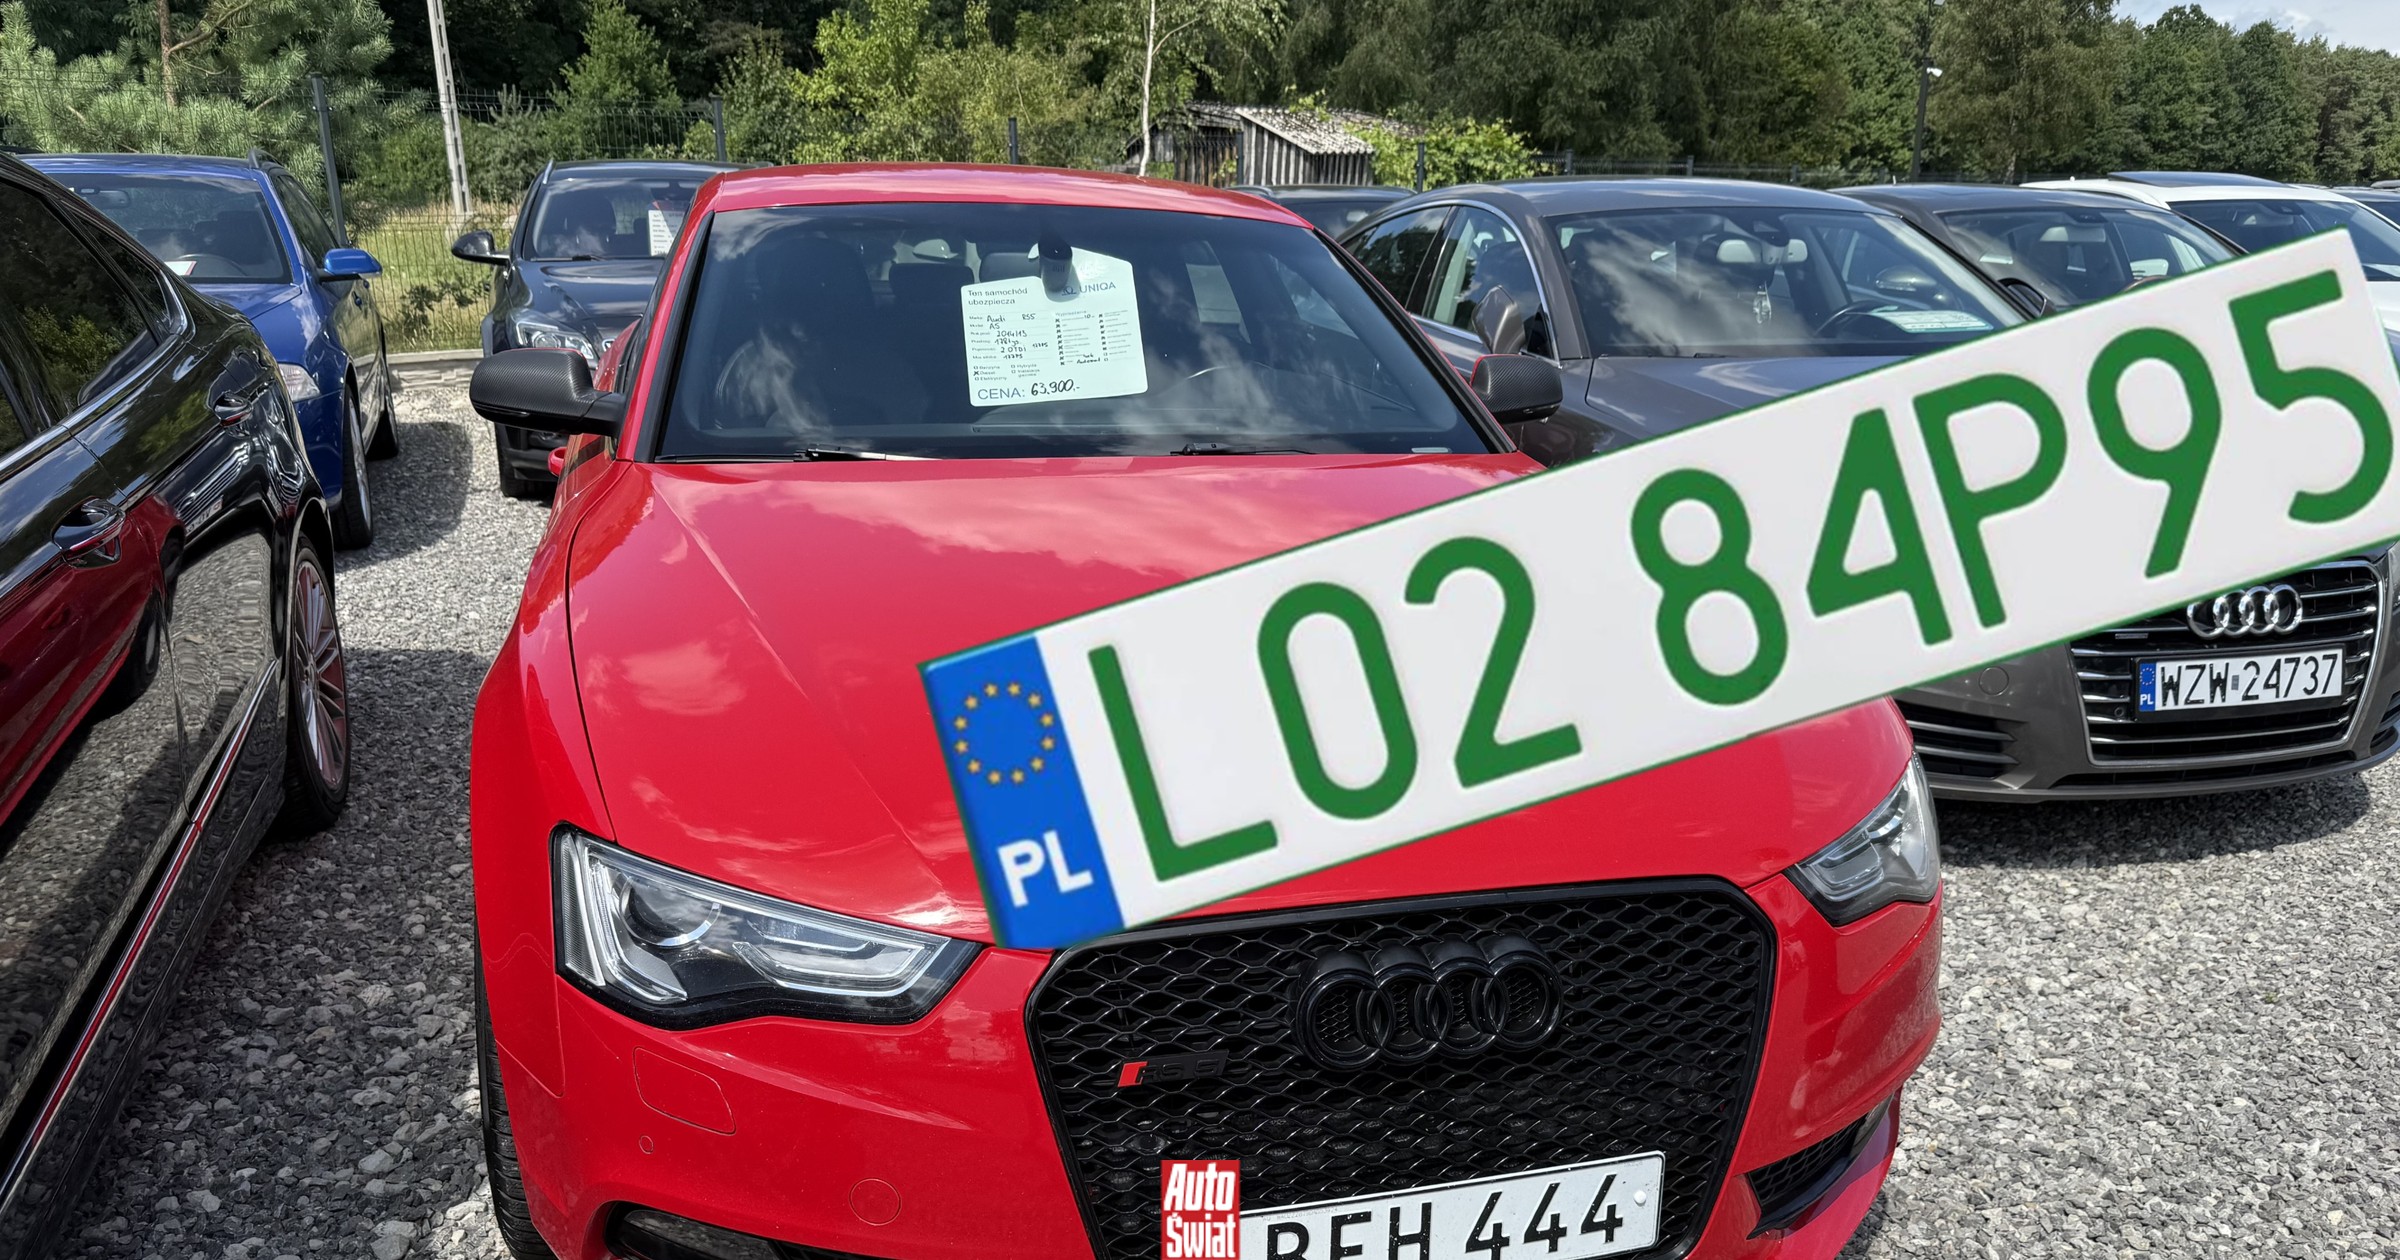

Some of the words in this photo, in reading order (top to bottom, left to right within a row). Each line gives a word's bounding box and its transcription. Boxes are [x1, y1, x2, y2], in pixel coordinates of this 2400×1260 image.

[985, 288, 1028, 296] samochód
[1080, 281, 1116, 293] UNIQA
[977, 387, 1026, 400] CENA:
[2160, 661, 2230, 707] WZW
[2240, 653, 2339, 702] 24737
[2139, 693, 2154, 705] PL
[1464, 1173, 1624, 1260] 444
